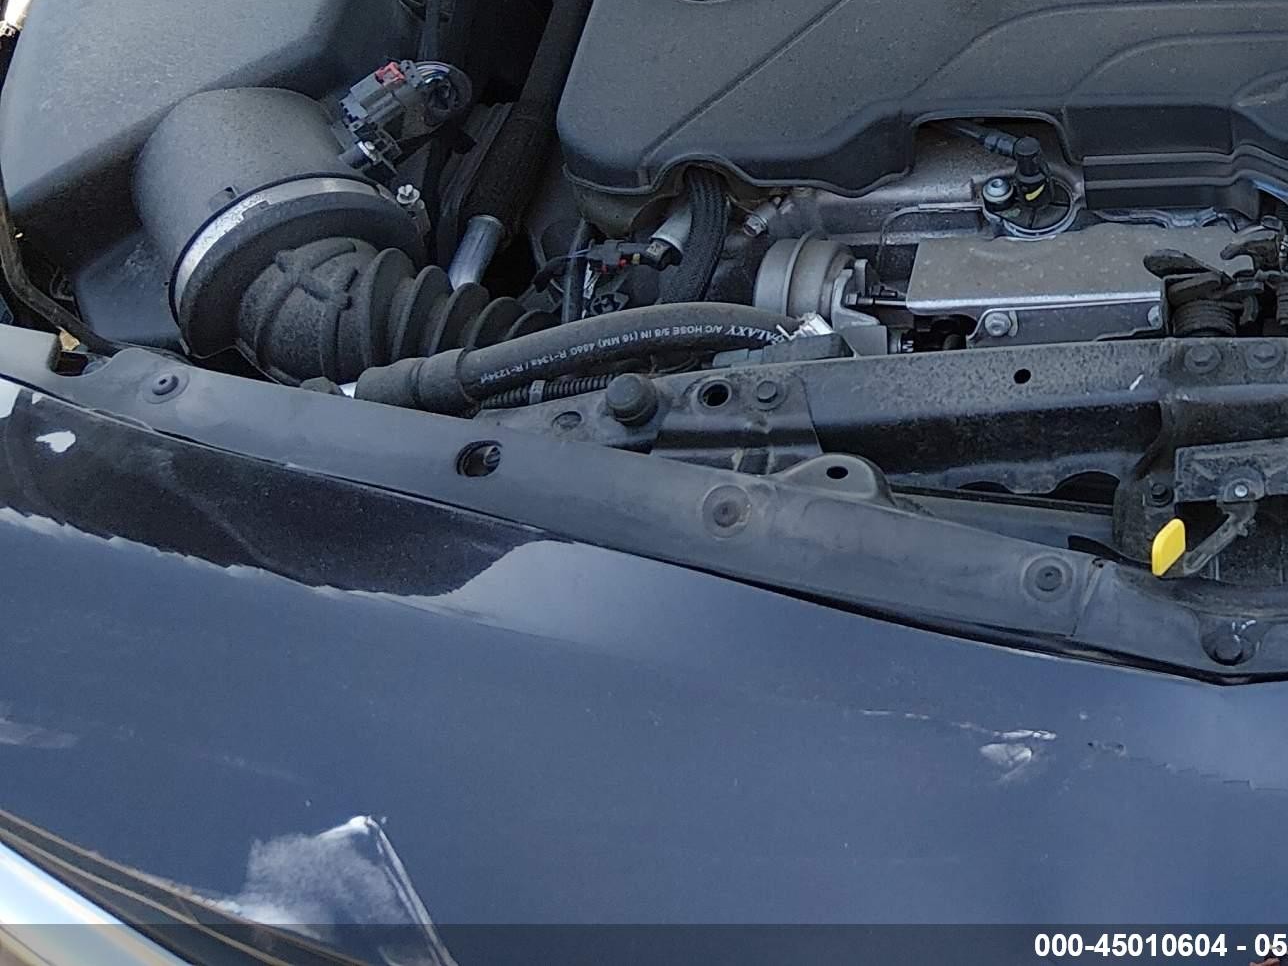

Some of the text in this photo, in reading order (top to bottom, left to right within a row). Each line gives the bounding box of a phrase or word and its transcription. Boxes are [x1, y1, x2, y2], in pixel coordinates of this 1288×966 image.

[640, 329, 652, 339] IN
[672, 325, 703, 336] HOSE
[704, 324, 723, 334] A/C
[597, 337, 621, 348] MM)
